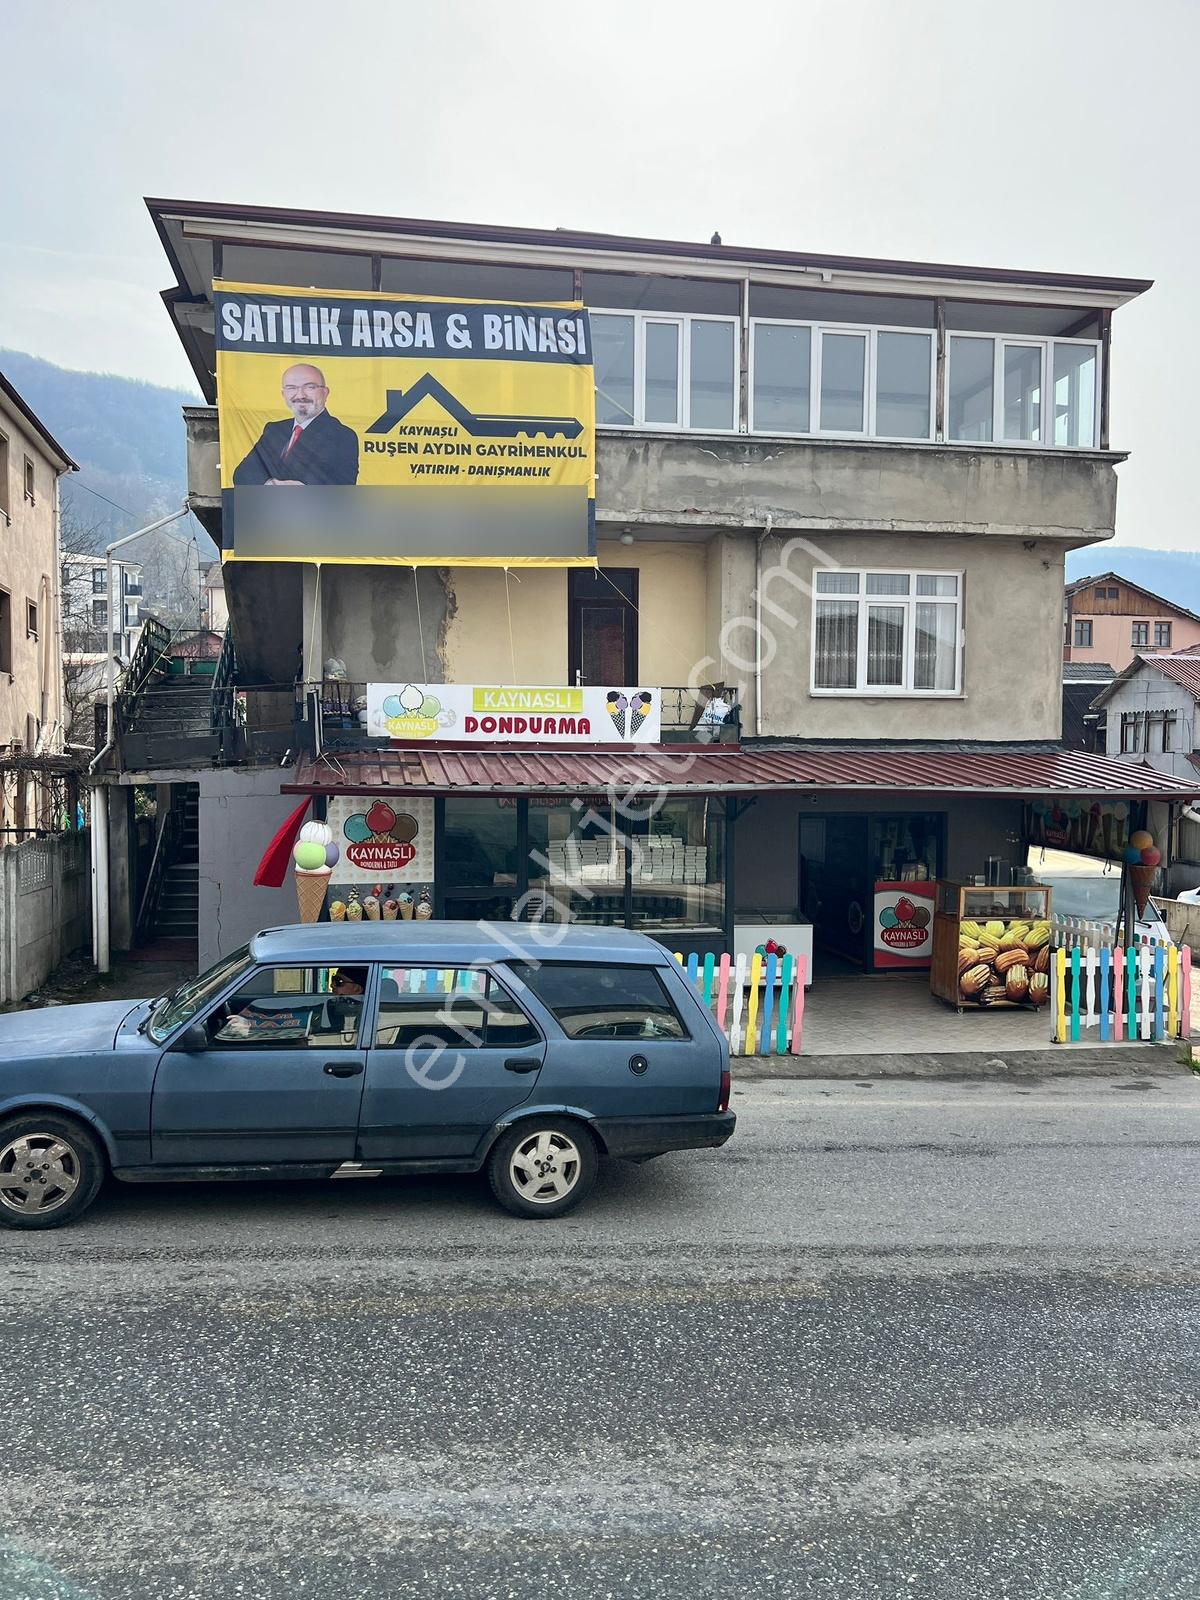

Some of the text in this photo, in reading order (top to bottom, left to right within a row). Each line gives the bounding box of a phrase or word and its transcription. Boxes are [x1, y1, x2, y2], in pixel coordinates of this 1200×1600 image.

[221, 302, 342, 346] SATILIK
[351, 309, 435, 349] ARSA
[446, 313, 473, 349] &
[399, 425, 458, 438] KAYNAŞLI
[364, 441, 587, 458] RUŞEN AYDIN GAYRİMENKUL
[410, 463, 460, 475] YATIRIM
[467, 465, 551, 478] DANIŞMANLIK
[464, 715, 591, 735] DONDURMA
[350, 847, 412, 860] KAYNAŞLI
